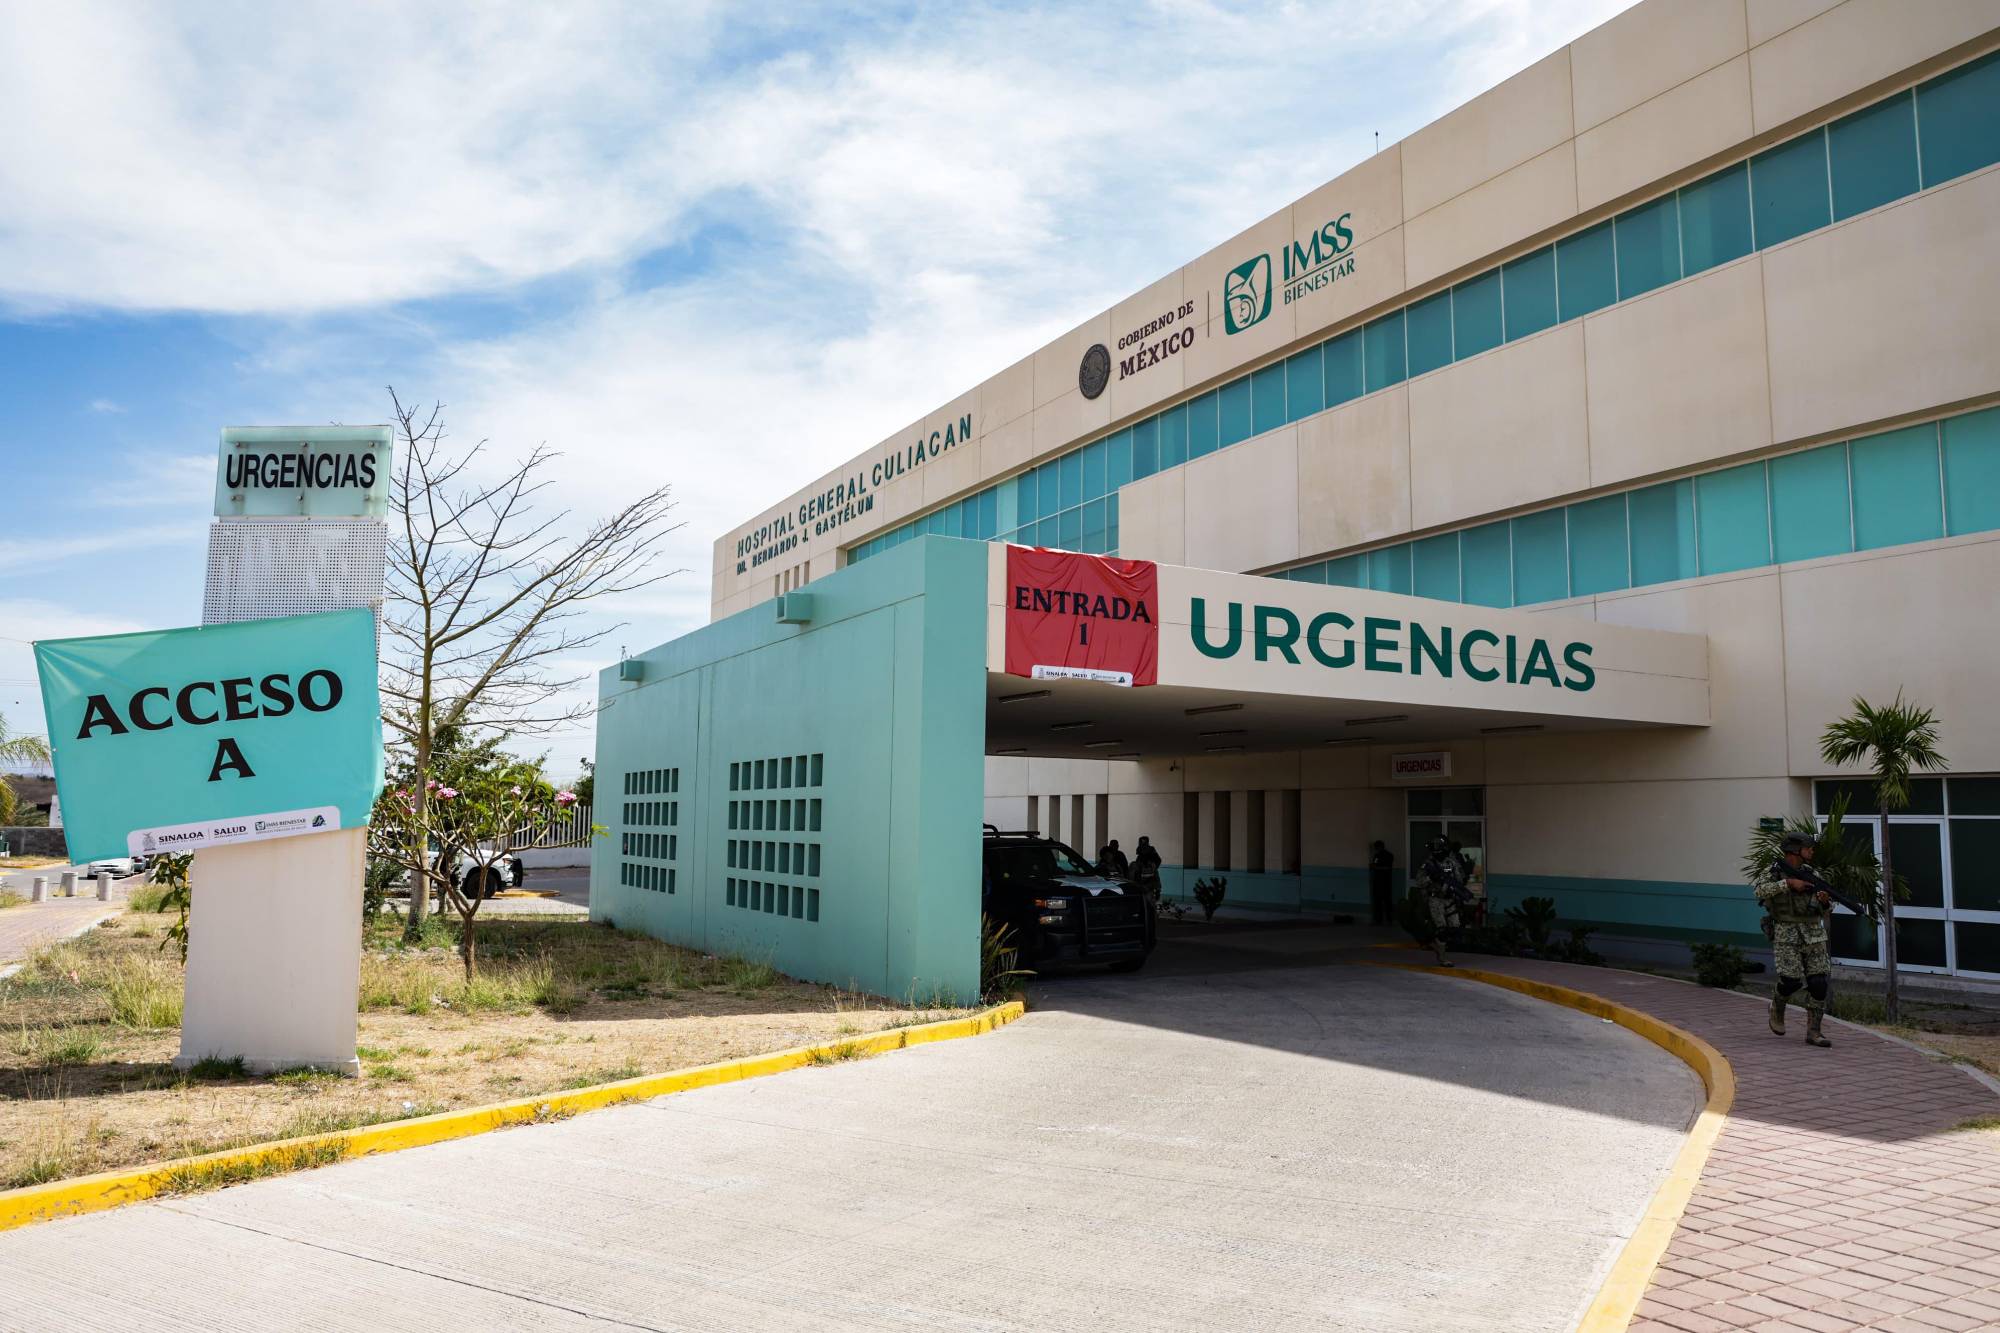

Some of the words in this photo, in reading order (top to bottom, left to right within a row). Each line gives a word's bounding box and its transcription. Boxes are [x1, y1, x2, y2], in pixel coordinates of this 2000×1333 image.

[1283, 213, 1353, 281] IMSS
[1284, 258, 1355, 305] BIENESTAR
[1118, 311, 1174, 350] GOBIERNO
[1177, 300, 1194, 320] DE
[1119, 326, 1195, 381] MÉXICO
[226, 453, 376, 488] URGENCIAS
[737, 512, 795, 558] HOSPITAL
[799, 472, 867, 525] GENERAL
[872, 413, 971, 486] CULIACAN
[752, 534, 798, 568] BERNARDO
[815, 494, 874, 536] GASTÉLUM
[1015, 586, 1151, 623] ENTRADA
[1079, 622, 1088, 645] 1
[1190, 597, 1596, 692] URGENCIAS
[76, 669, 343, 740] ACCESO
[207, 738, 256, 782] A
[1396, 759, 1441, 773] URGENCIAS
[158, 831, 204, 843] SINALOA
[213, 825, 247, 836] SALUD
